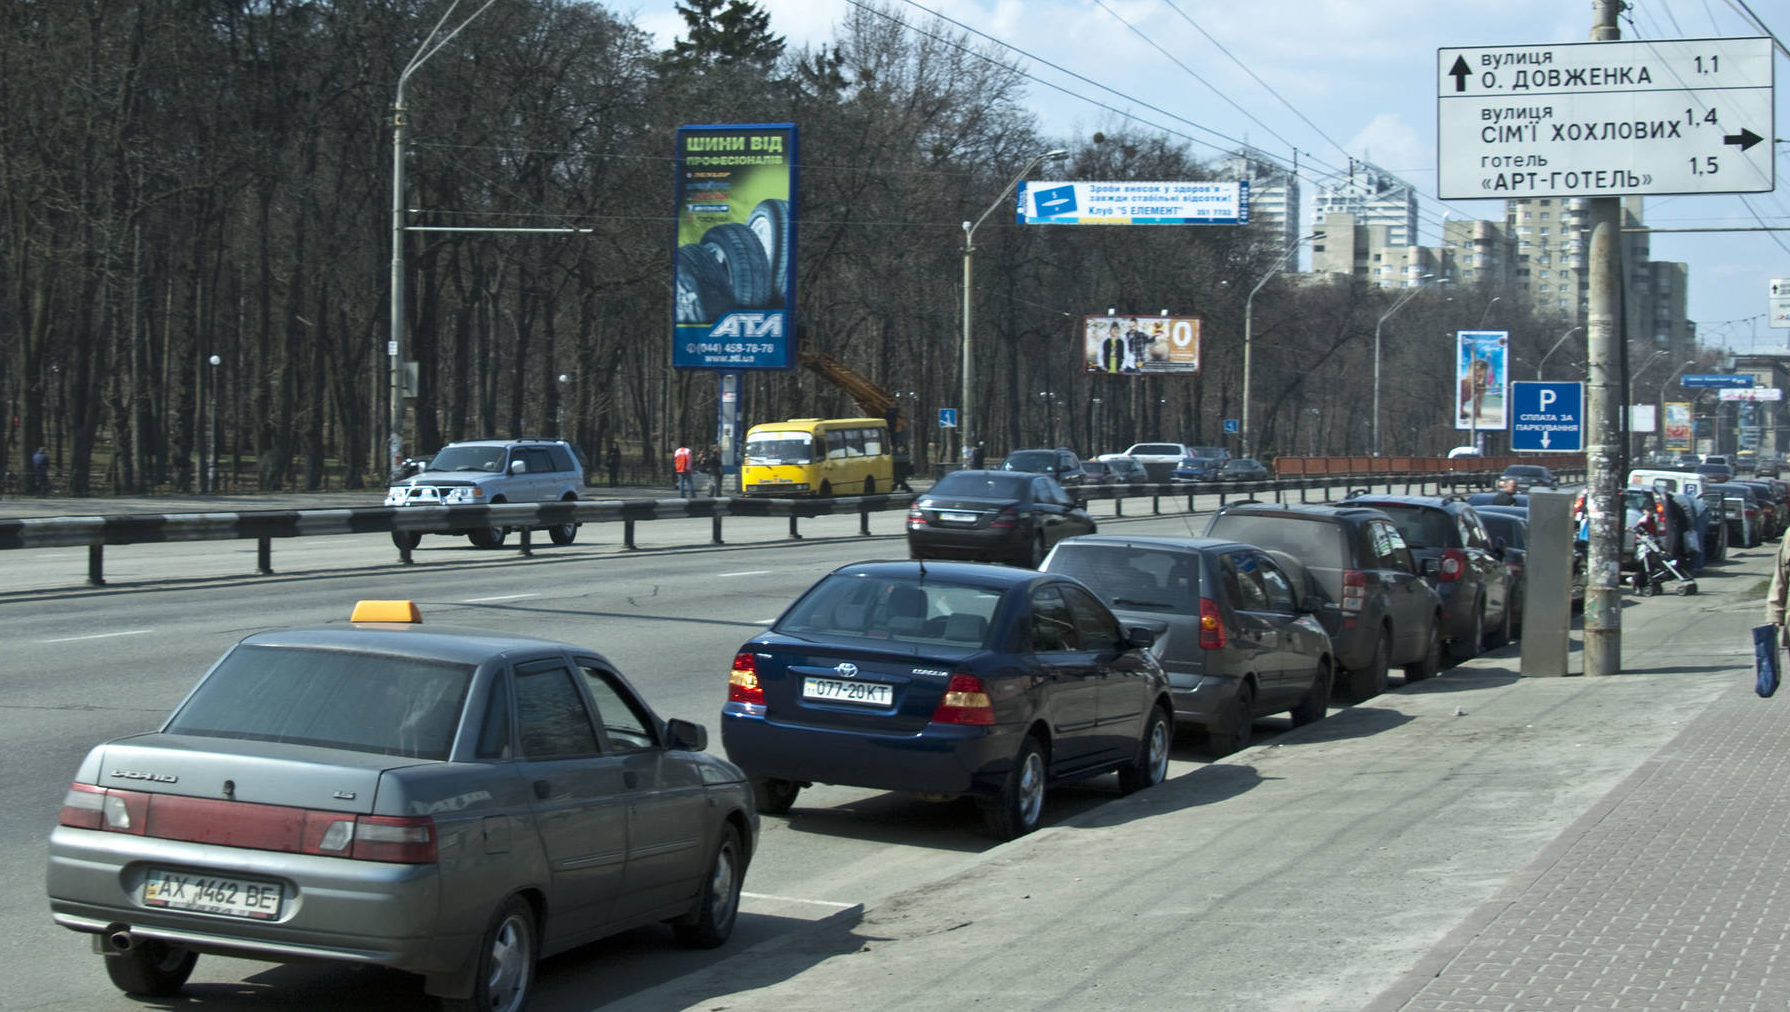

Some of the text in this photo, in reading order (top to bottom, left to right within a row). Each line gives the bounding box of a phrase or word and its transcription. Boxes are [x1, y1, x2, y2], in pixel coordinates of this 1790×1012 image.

[1481, 51, 1553, 69] вулиця
[1693, 55, 1719, 75] 1,1
[1482, 66, 1653, 91] О. ДОВЖЕНКА
[1481, 105, 1553, 122] вулиця
[1685, 107, 1718, 128] 1,4
[1552, 119, 1682, 142] ХОХЛОВИХ
[686, 136, 783, 153] ШИНИ ВІД
[686, 155, 783, 166] ПРОФЕСІОНАЛІВ
[1481, 154, 1548, 168] готель
[1689, 156, 1719, 175] 1,5
[1088, 184, 1121, 194] Зроби
[1481, 169, 1653, 191] «АРТ-ГОТЕЛЬ»
[1088, 206, 1114, 216] Клуб
[1130, 206, 1184, 215] ЕЛЕМЕНТ"
[1540, 389, 1557, 412] P
[1520, 413, 1558, 421] СПЛАТА
[1515, 424, 1578, 432] ПАРКУВАННЯ
[194, 879, 239, 905] 1462
